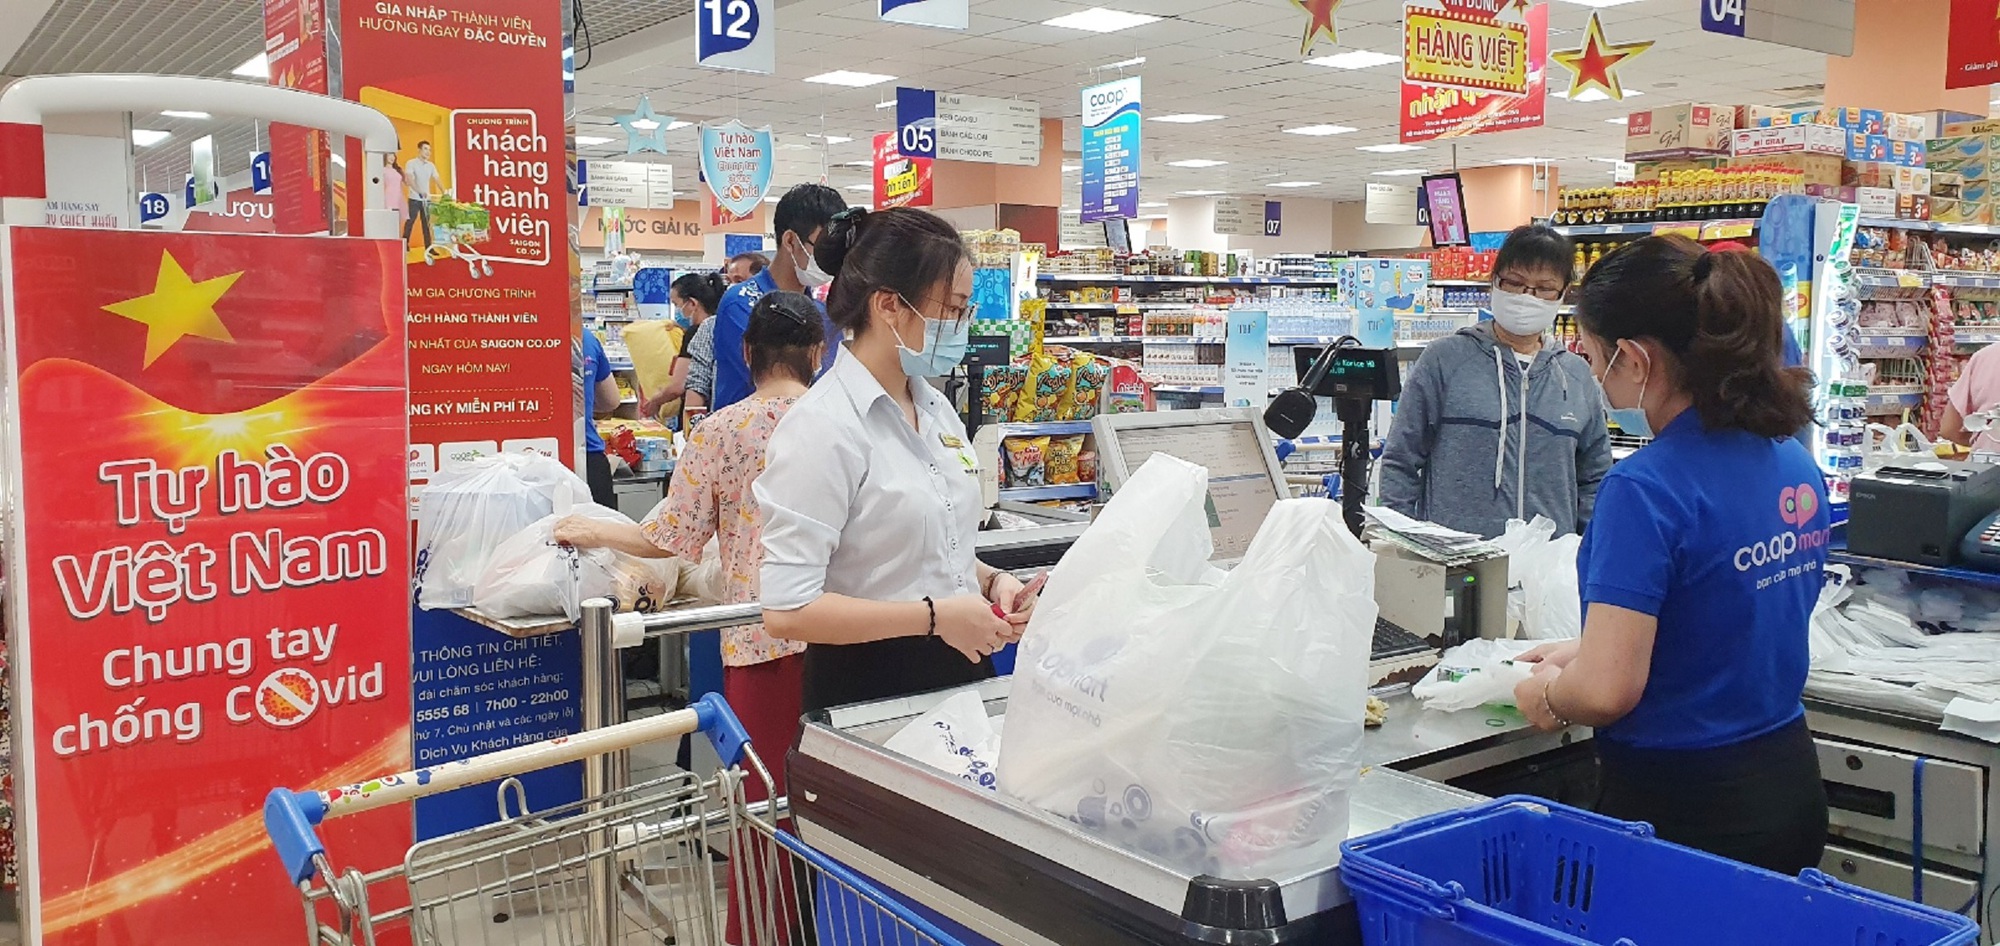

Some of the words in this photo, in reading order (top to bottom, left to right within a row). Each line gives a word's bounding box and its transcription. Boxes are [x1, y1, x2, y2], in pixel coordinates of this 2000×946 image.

[375, 2, 402, 16] GIA
[406, 4, 448, 21] NHẬP
[451, 10, 498, 27] THÀNH
[501, 16, 532, 31] VIÊN
[704, 0, 752, 39] 12
[1709, 0, 1744, 26] 04
[422, 25, 460, 38] NGAY
[464, 27, 495, 44] ĐẶC
[498, 31, 547, 48] QUYỀN
[1416, 22, 1473, 66] HÀNG
[1478, 33, 1518, 74] VIỆT
[467, 128, 547, 153] khách
[719, 132, 733, 146] Tự
[735, 131, 755, 144] hào
[903, 124, 933, 152] 05
[1630, 124, 1650, 133] VIFON
[714, 146, 735, 160] Việt
[738, 147, 762, 158] Nam
[484, 154, 548, 185] hàng
[143, 199, 165, 215] 18
[474, 184, 549, 210] thành
[496, 213, 550, 237] viên
[1266, 219, 1280, 234] 07
[509, 238, 541, 247] SAIGON
[516, 248, 541, 256] CO.OP
[425, 288, 446, 298] GIA
[448, 286, 501, 298] CHƯƠNG
[503, 287, 537, 299] TRÌNH
[434, 311, 468, 324] HÀNG
[471, 311, 511, 324] THÀNH
[512, 311, 538, 324] VIÊN
[420, 337, 452, 350] NHẤT
[453, 337, 478, 350] CỦA
[480, 339, 524, 350] SAIGON
[526, 338, 562, 349] CO.OP
[422, 364, 453, 375] NGAY
[456, 361, 484, 374] HÔM
[486, 362, 511, 374] NAY!
[434, 400, 453, 415] KÝ
[456, 397, 490, 413] MIỄN
[493, 397, 516, 413] PHÍ
[518, 399, 539, 414] TẠI
[100, 458, 209, 534] Tự
[216, 443, 349, 513] hào
[53, 540, 216, 622] Việt
[230, 528, 387, 595] Nam
[1757, 575, 1772, 590] bạn
[103, 636, 252, 687] Chung
[266, 623, 338, 662] tay
[420, 645, 473, 664] THÔNG
[476, 642, 499, 656] TIN
[503, 638, 528, 652] CHI
[438, 663, 479, 681] LÒNG
[483, 657, 515, 674] LIÊN
[519, 653, 542, 669] HỆ:
[418, 688, 436, 701] đài
[440, 685, 471, 699] chăm
[474, 681, 495, 693] sóc
[498, 676, 530, 690] khách
[533, 671, 564, 685] hàng:
[53, 697, 201, 756] chống
[226, 662, 384, 726] Covid
[416, 707, 450, 723] 5555
[453, 704, 470, 717] 68
[485, 697, 518, 712] 7h00
[530, 689, 569, 705] 22h00
[447, 723, 470, 736] Chủ
[472, 719, 496, 733] nhật
[498, 716, 511, 727] và
[514, 714, 533, 726] các
[535, 710, 559, 724] ngày
[420, 746, 448, 761] Dịch
[452, 743, 468, 755] Vụ
[472, 735, 510, 752] Khách
[513, 732, 544, 746] Hàng
